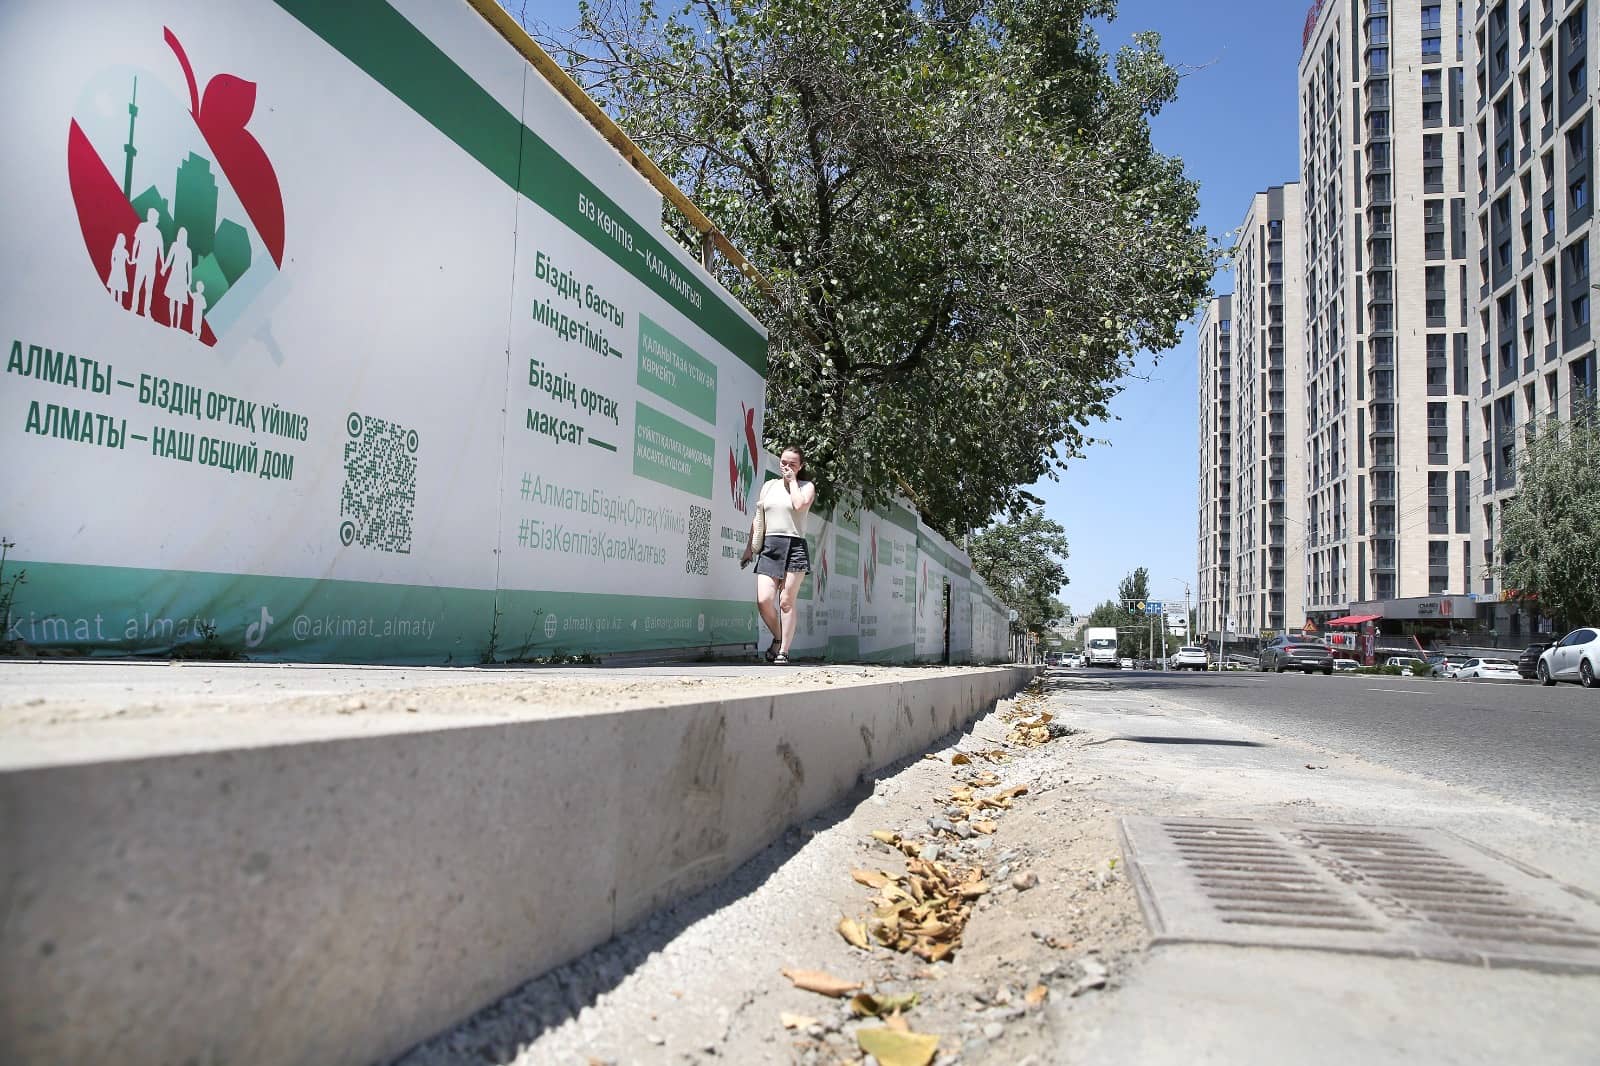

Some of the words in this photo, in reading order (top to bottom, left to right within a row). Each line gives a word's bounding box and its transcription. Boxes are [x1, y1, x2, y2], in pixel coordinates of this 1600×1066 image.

[535, 250, 581, 308] Біздің
[585, 284, 624, 329] басты
[578, 192, 595, 222] БІЗ
[597, 207, 633, 252] КӨППІЗ
[669, 268, 702, 310] ЖАЛҒЫЗ!
[6, 340, 112, 395] АЛМАТЫ
[139, 373, 201, 420] БІЗДІҢ
[206, 391, 256, 433] ОРТАҚ
[261, 402, 309, 441] ҮЙІМІЗ
[526, 408, 584, 445] мақсат
[528, 358, 576, 409] Біздің
[581, 388, 619, 426] ортақ
[25, 400, 127, 449] АЛМАТЫ
[152, 426, 194, 462] НАШ
[199, 436, 257, 474] ОБЩИЙ
[260, 449, 294, 480] ДОМ
[292, 614, 436, 641] @akimat_almaty
